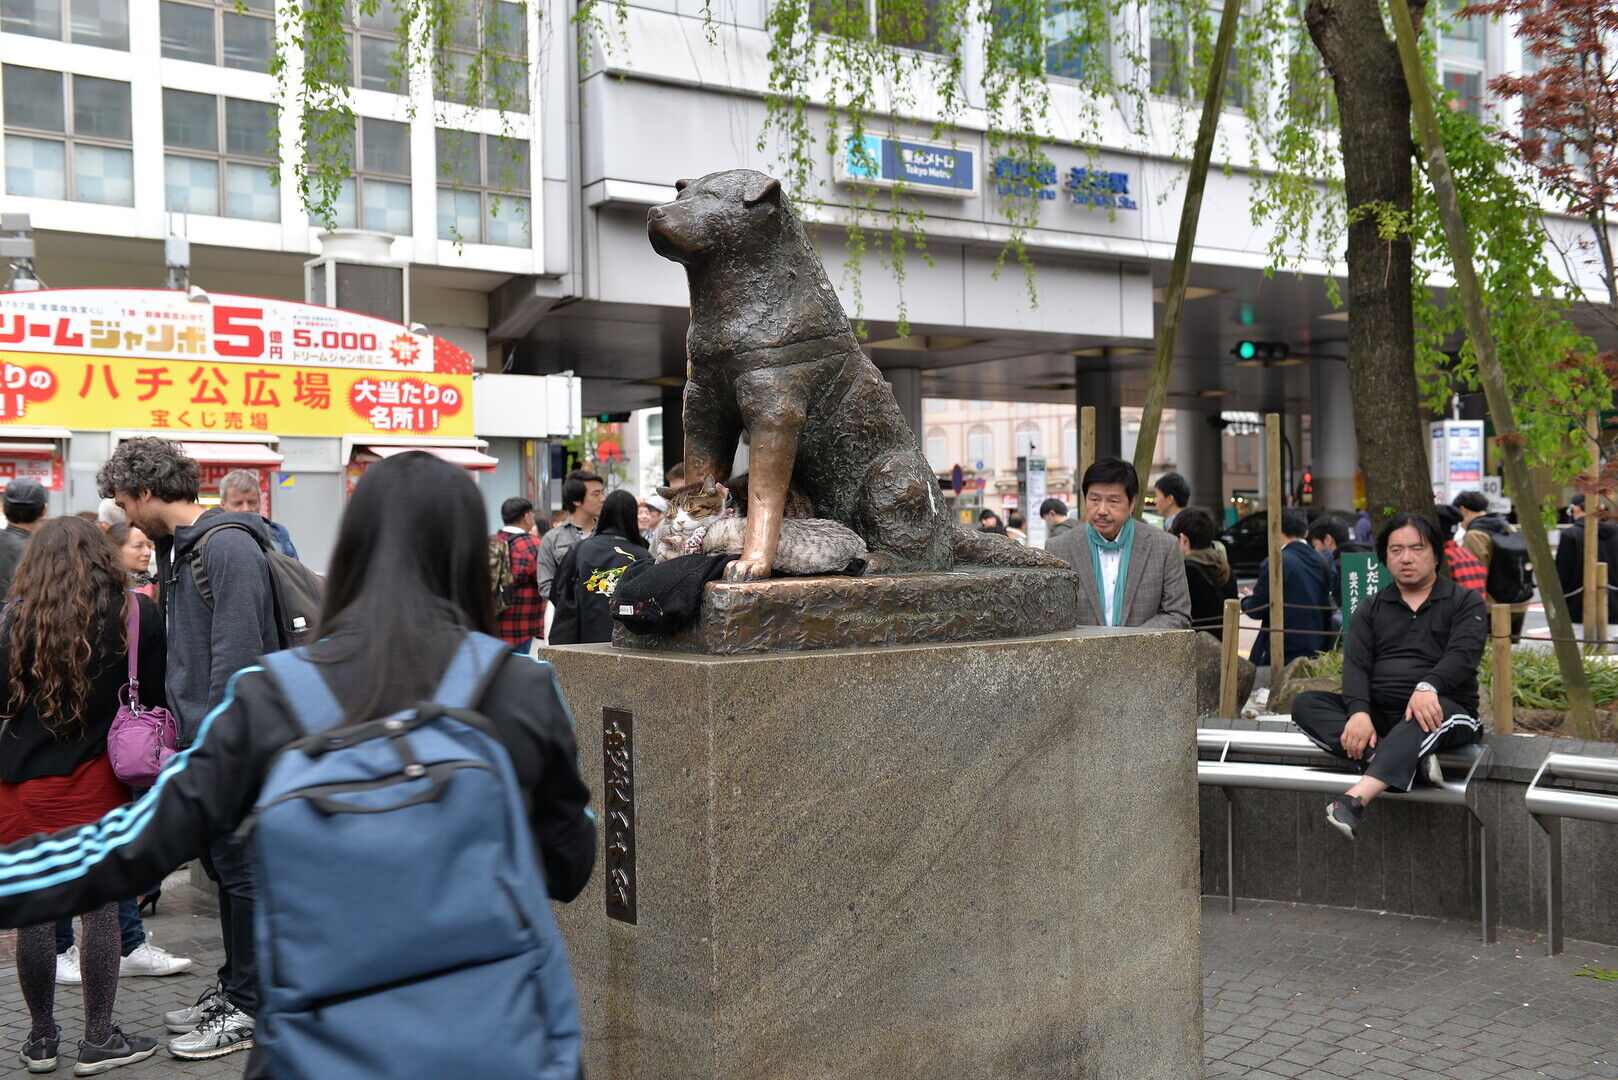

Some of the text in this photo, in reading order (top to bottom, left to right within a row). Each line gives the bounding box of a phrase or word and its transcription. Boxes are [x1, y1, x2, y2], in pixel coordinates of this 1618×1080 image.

[906, 164, 928, 177] Tokyo
[213, 306, 265, 358] 5
[0, 363, 52, 389] りの
[78, 363, 333, 411] ハチ公広場
[354, 380, 459, 405] 大当たりの
[150, 409, 269, 431] 宝くじ売場
